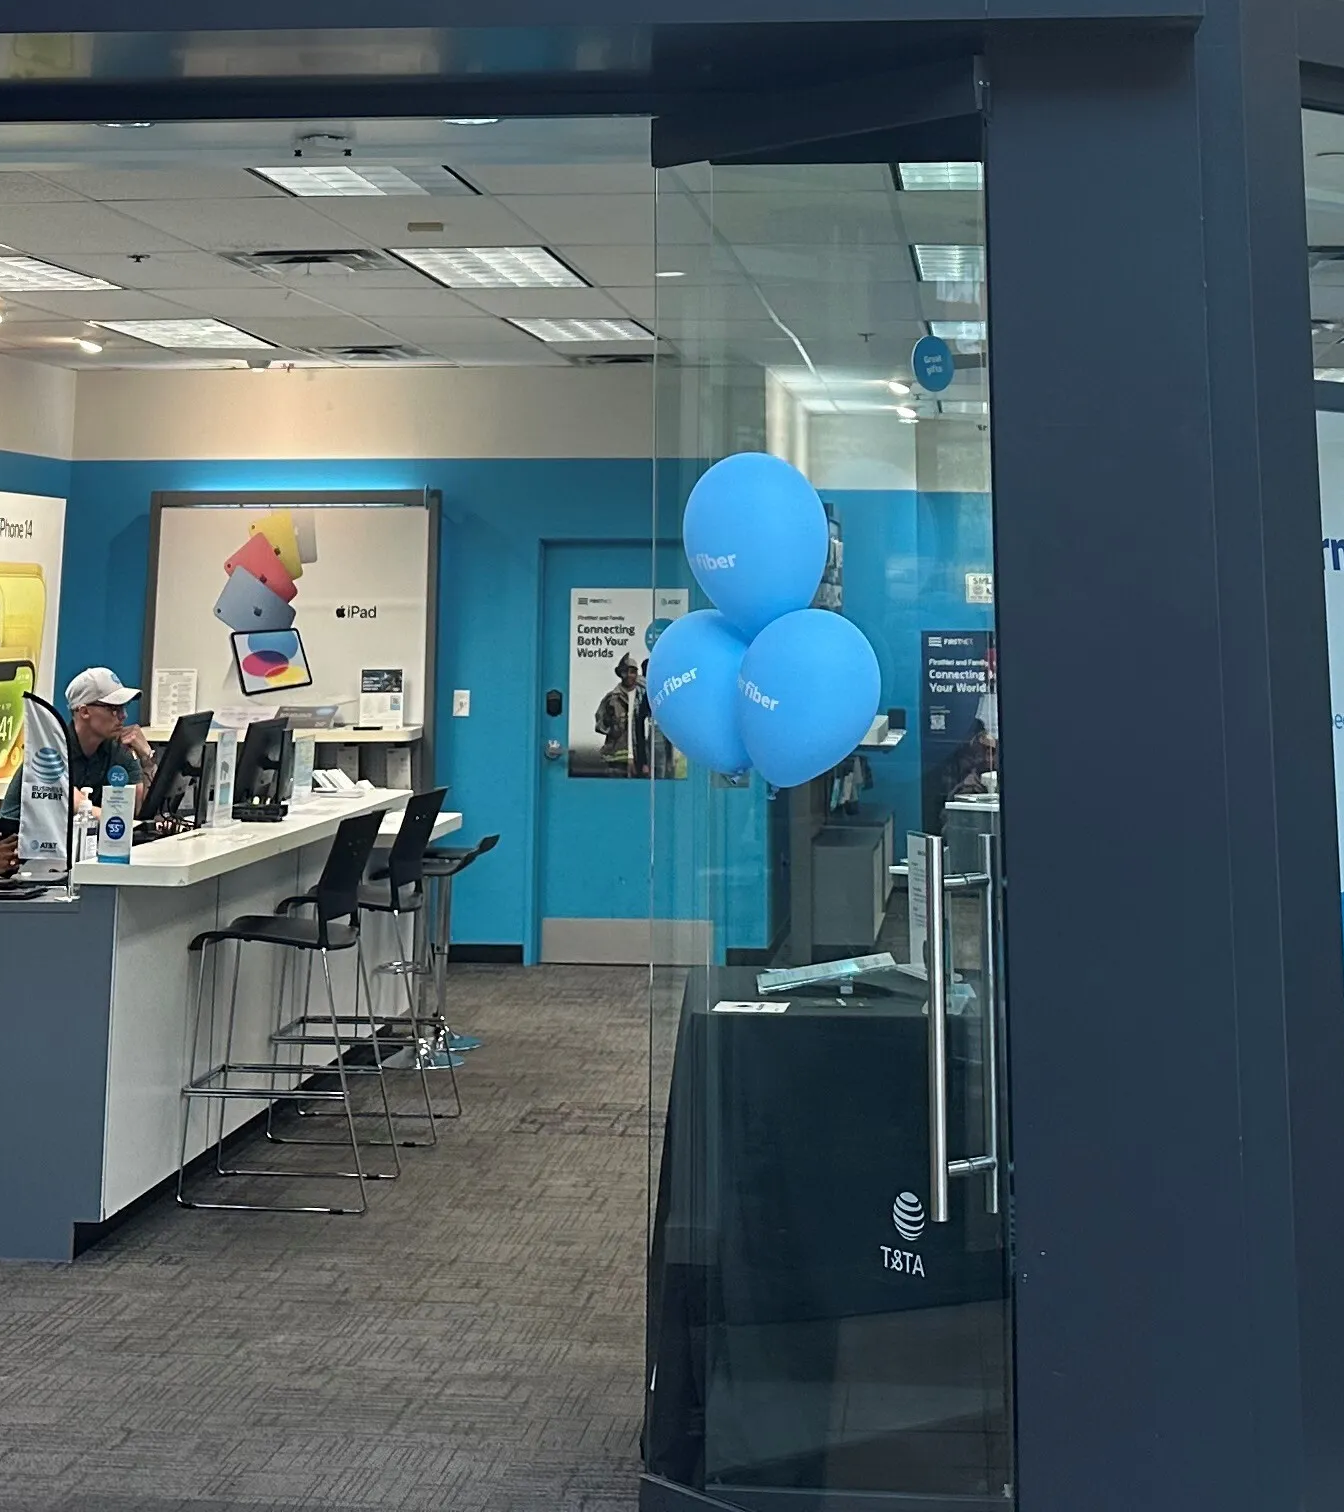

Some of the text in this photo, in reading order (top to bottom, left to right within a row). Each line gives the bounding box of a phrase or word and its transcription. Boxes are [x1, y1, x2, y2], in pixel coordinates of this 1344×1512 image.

[24, 519, 33, 539] 14
[347, 604, 377, 620] iPad
[577, 624, 636, 636] Connecting
[577, 636, 629, 646] Both Your
[576, 648, 614, 658] Worlds
[663, 667, 698, 697] fiber
[929, 669, 986, 682] Connecting
[929, 682, 954, 694] Your
[745, 680, 780, 712] fiber
